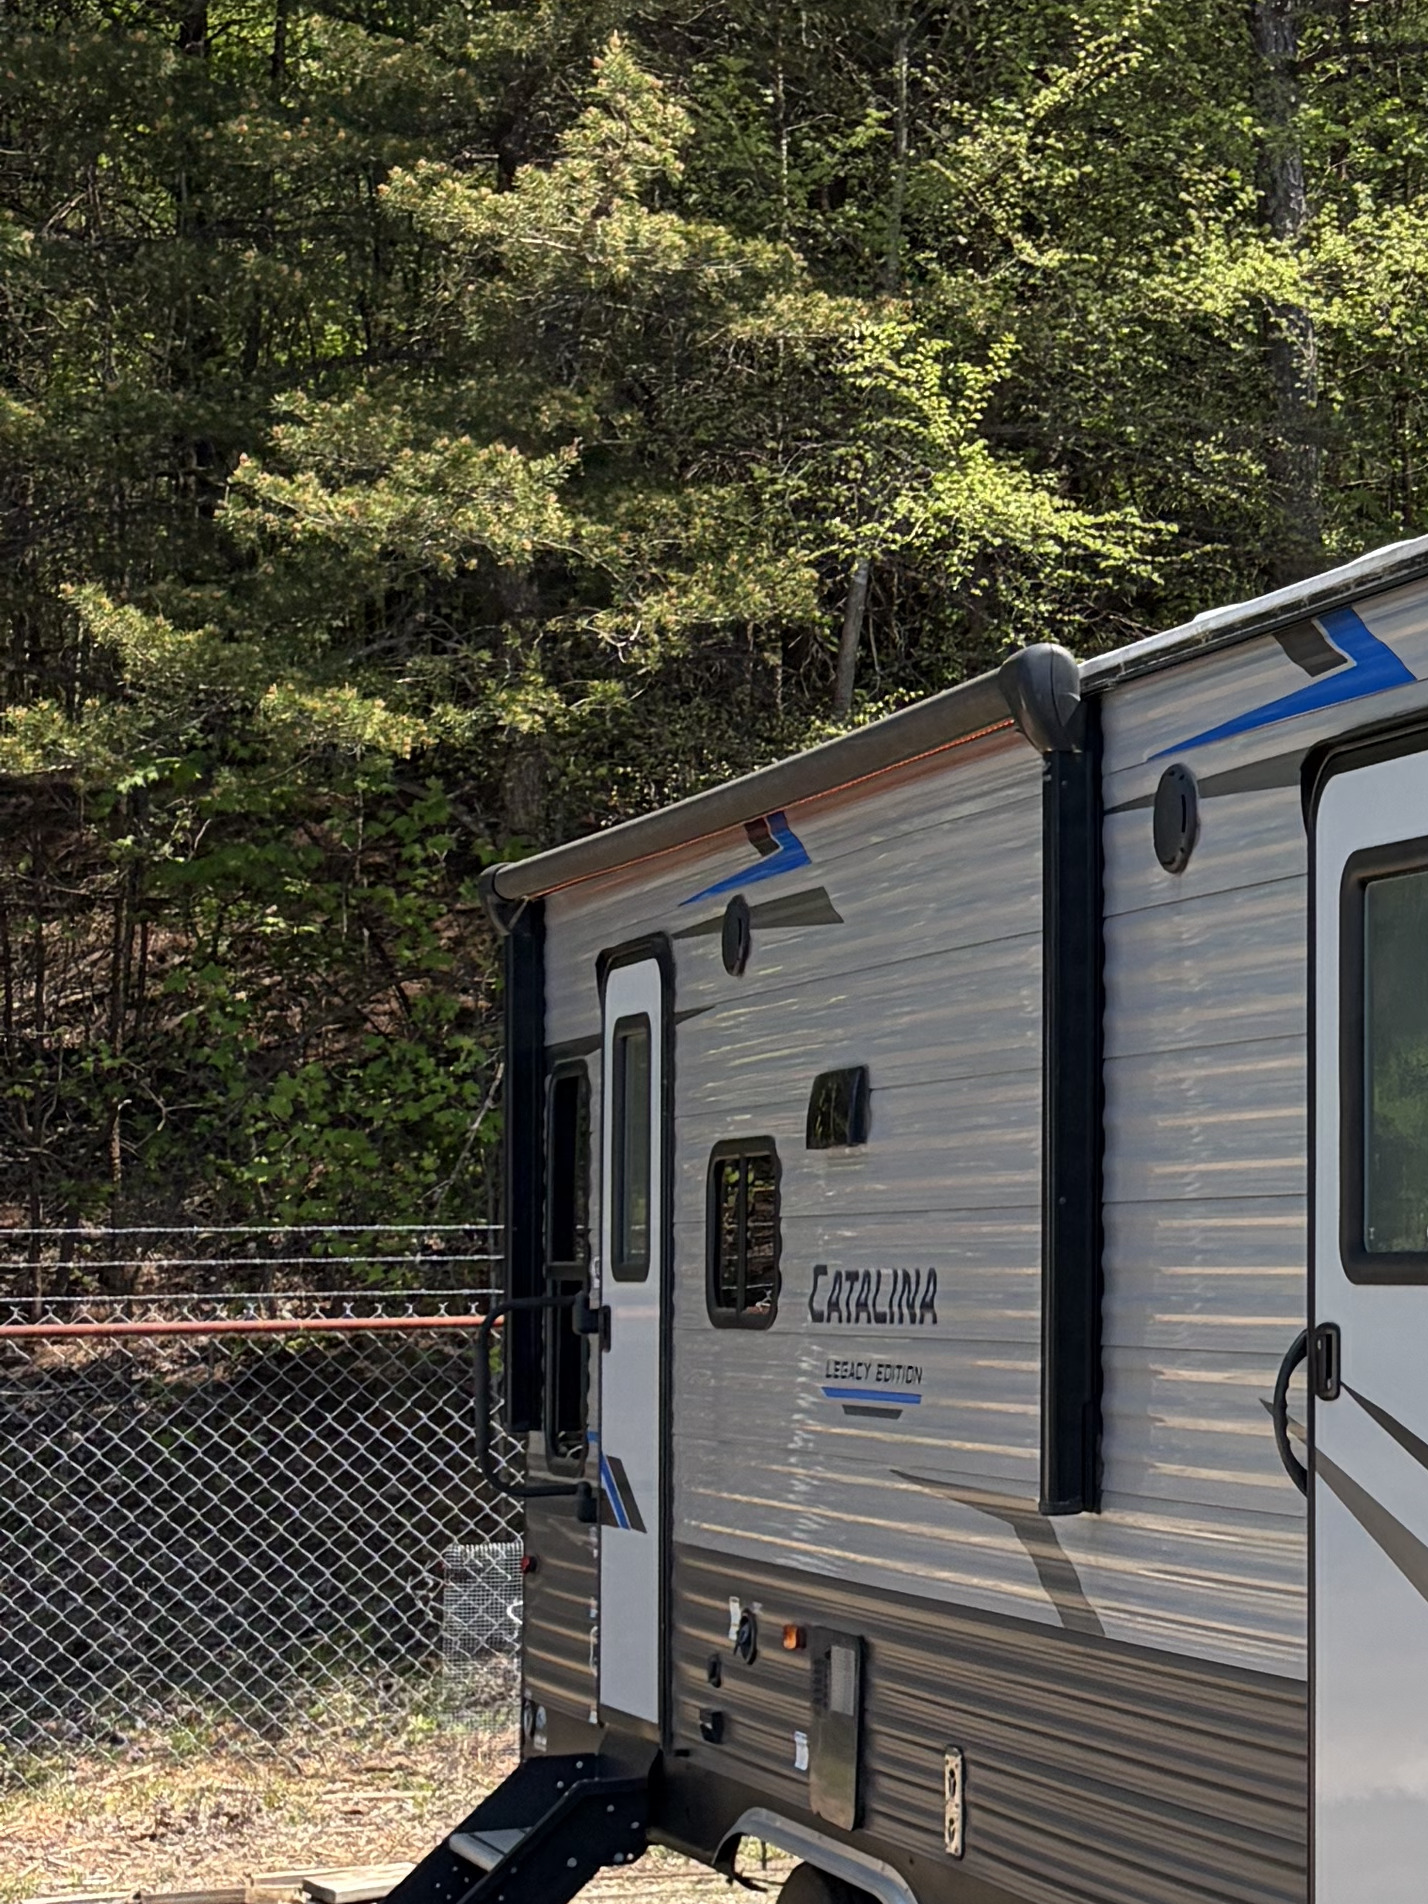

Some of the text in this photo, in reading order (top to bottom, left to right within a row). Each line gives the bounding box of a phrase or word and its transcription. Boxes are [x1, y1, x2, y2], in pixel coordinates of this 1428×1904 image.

[808, 1264, 938, 1324] CATALINA
[825, 1359, 923, 1385] LEGACY EDITION
